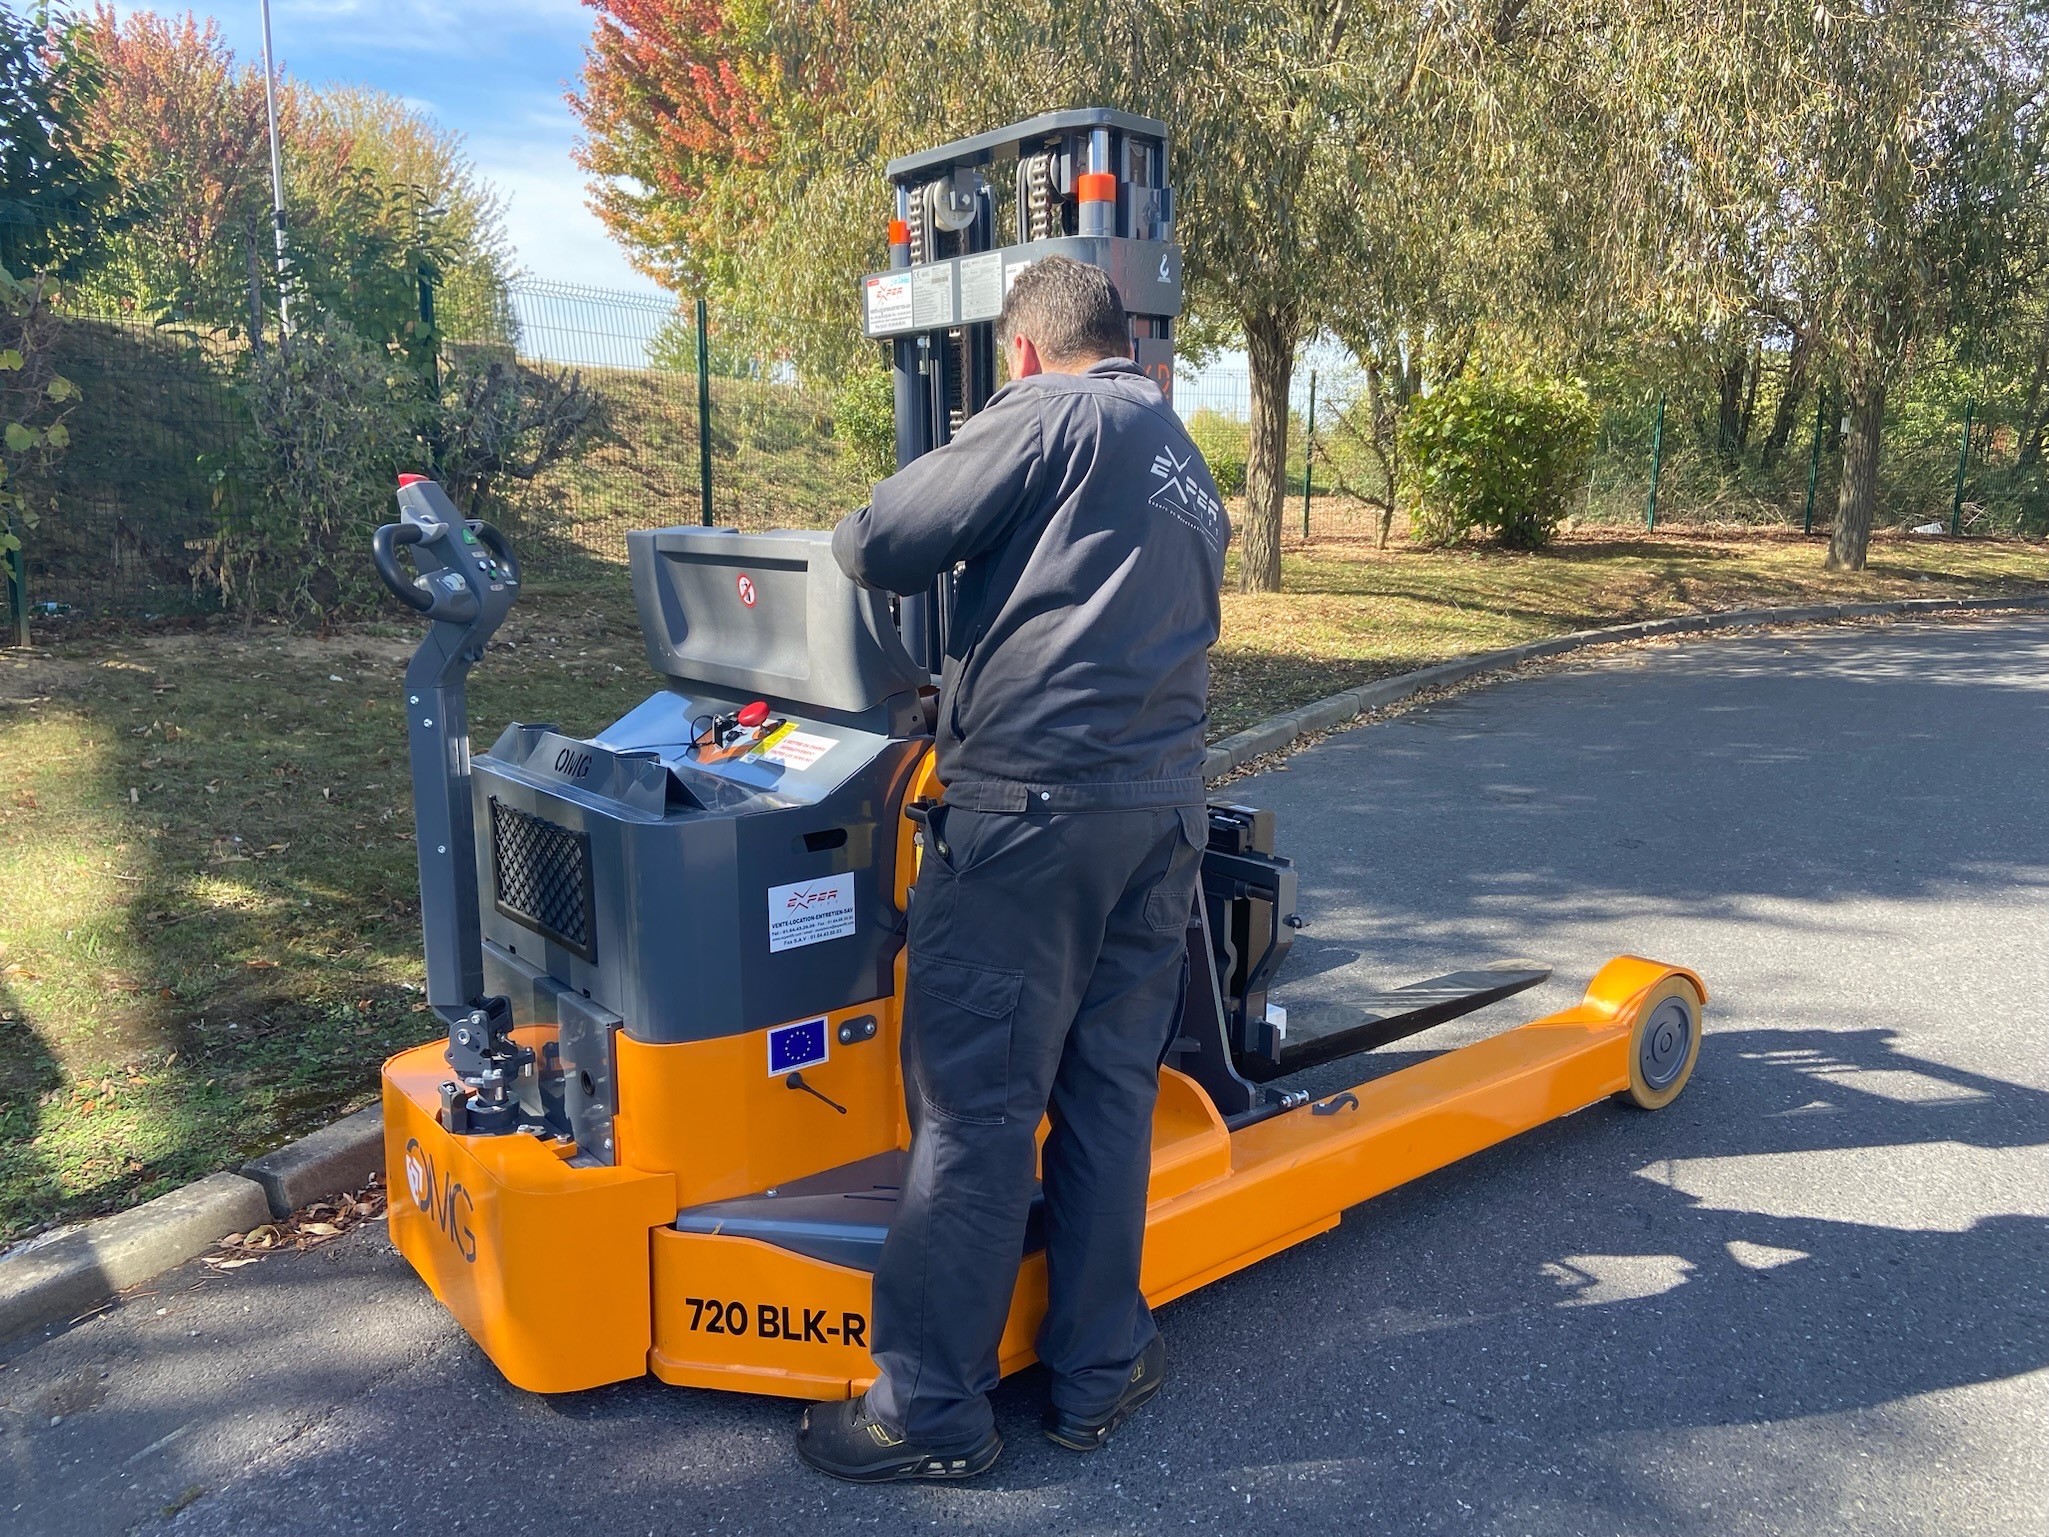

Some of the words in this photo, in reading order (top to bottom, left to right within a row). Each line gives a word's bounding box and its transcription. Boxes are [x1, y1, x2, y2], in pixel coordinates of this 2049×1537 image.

[555, 748, 592, 777] OMG
[405, 1138, 476, 1263] OMG
[685, 1297, 748, 1336] 720
[758, 1304, 867, 1348] BLK-R
